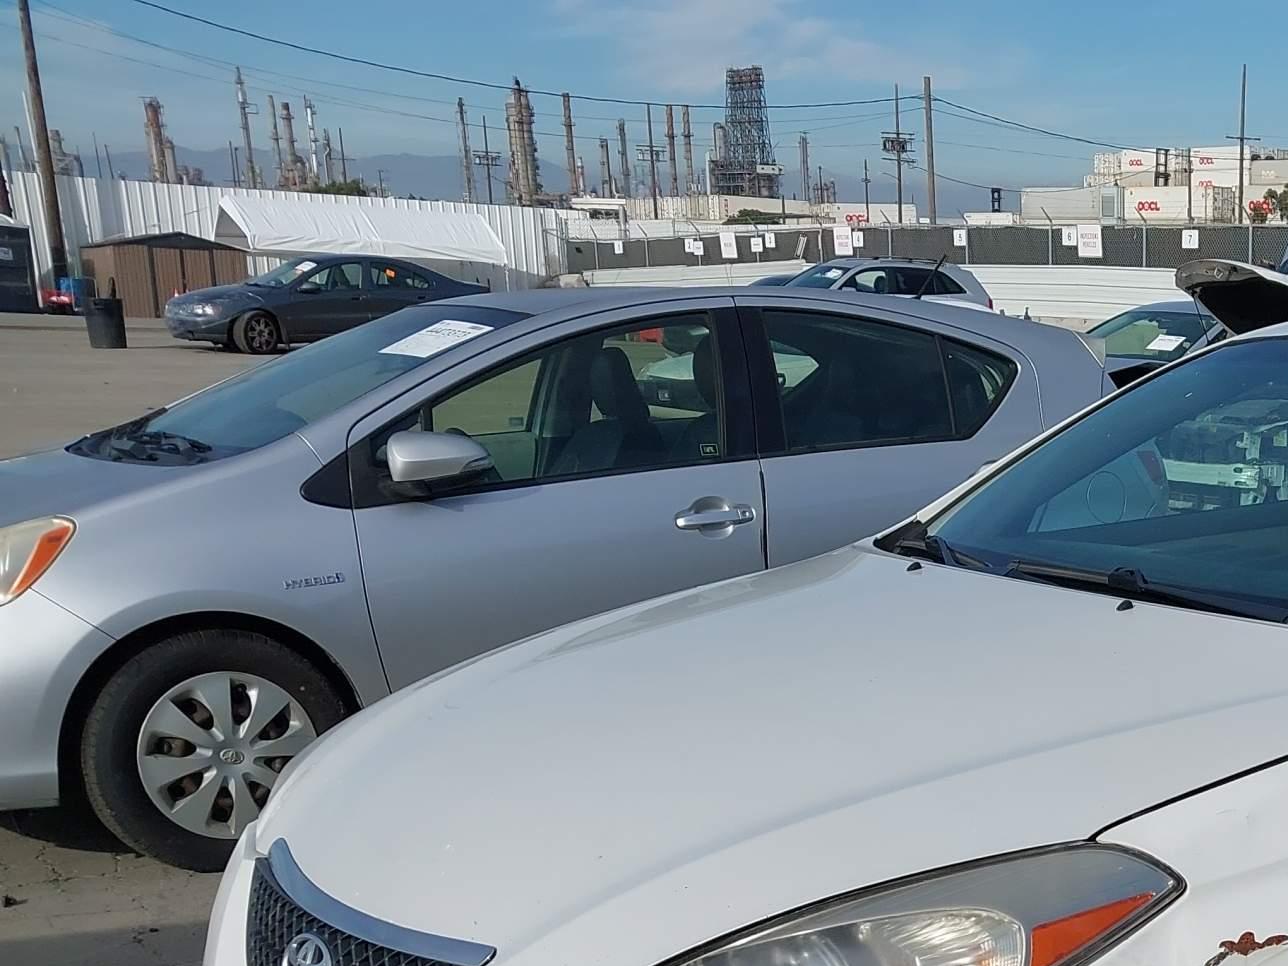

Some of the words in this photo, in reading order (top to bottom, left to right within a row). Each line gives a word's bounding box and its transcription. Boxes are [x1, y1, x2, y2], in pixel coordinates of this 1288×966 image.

[1129, 159, 1144, 167] OOCL
[1199, 157, 1214, 165] OOCL
[1137, 201, 1161, 212] OOCL
[1067, 231, 1072, 241] 6
[1187, 234, 1193, 245] 7
